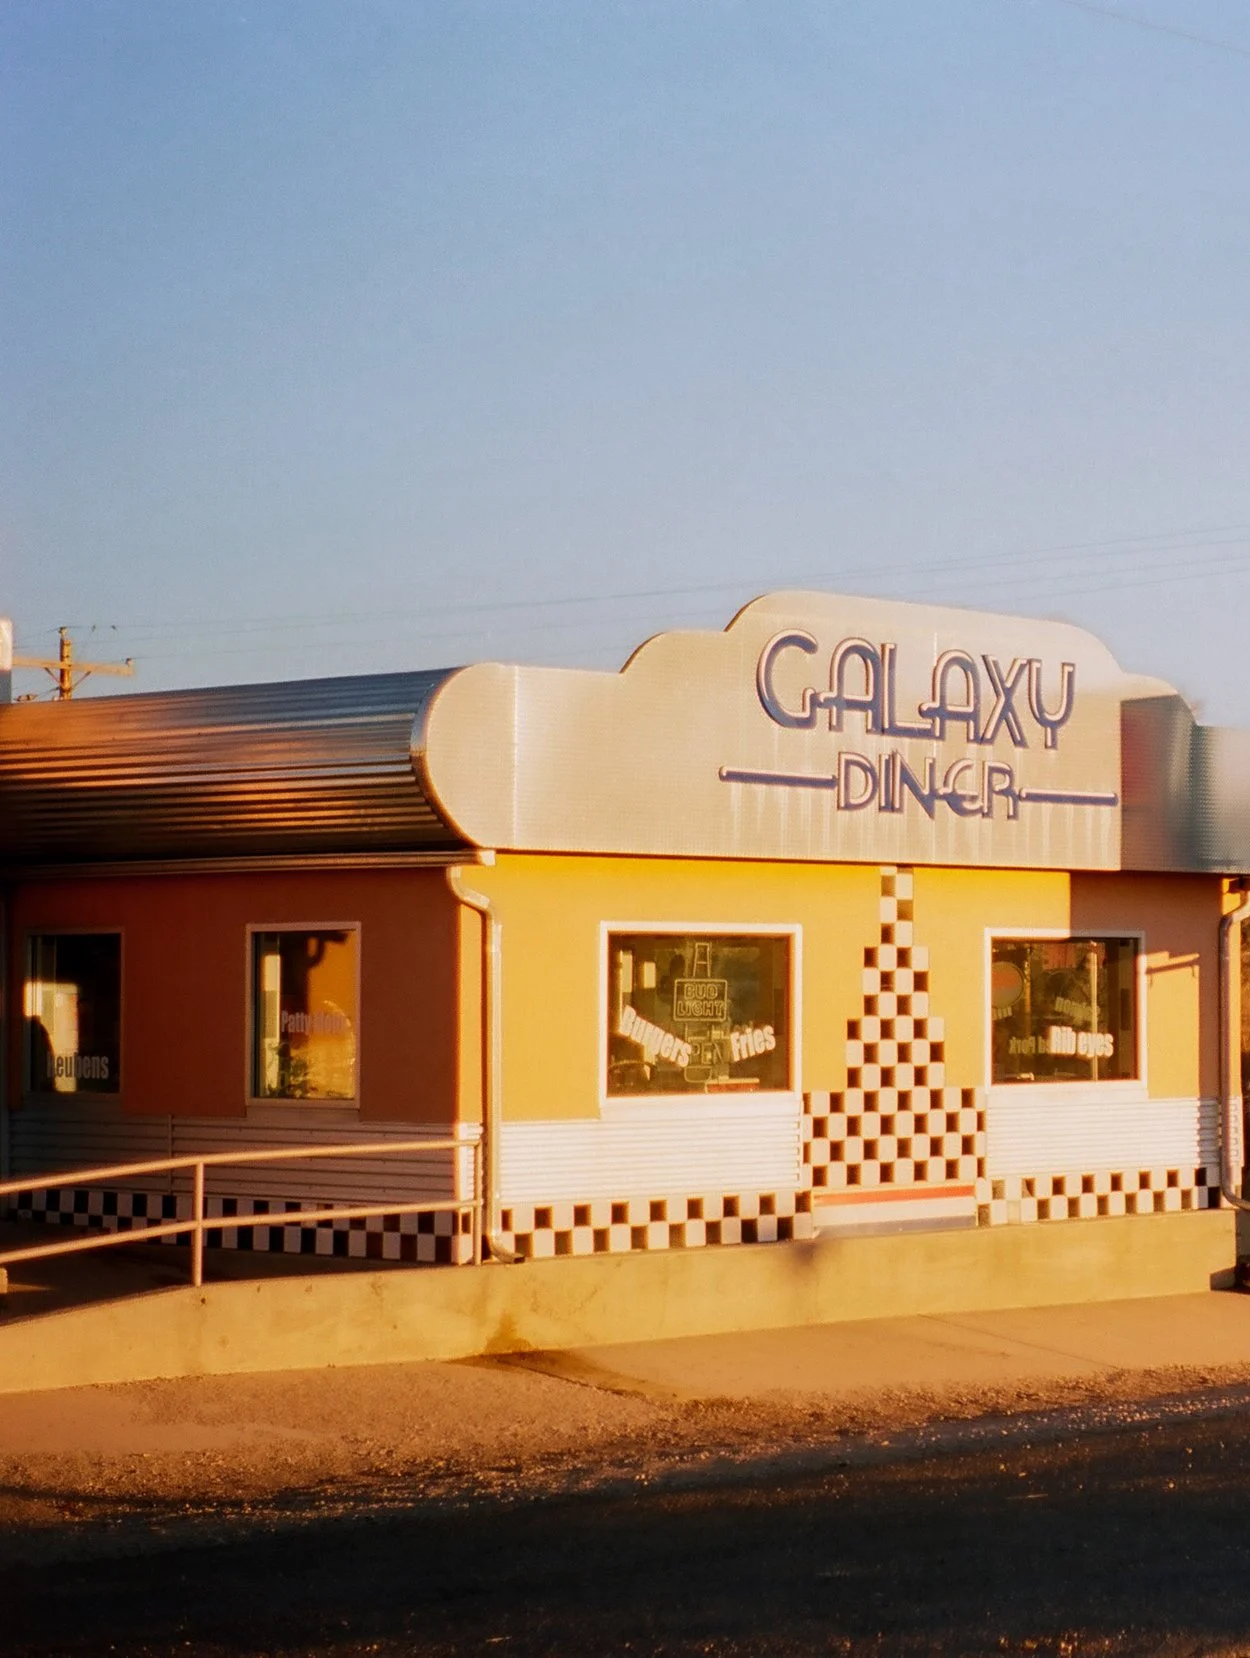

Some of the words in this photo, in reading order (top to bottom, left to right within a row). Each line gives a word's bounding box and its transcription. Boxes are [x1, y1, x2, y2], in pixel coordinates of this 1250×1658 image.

[756, 628, 1076, 750] GALAXY
[836, 750, 1019, 820] DINER
[677, 1000, 724, 1016] LIGHT
[684, 983, 718, 999] BUD
[619, 1005, 692, 1067] Burgers
[730, 1024, 776, 1062] Fries
[1050, 1026, 1076, 1055] Rib
[1078, 1032, 1114, 1057] eyes
